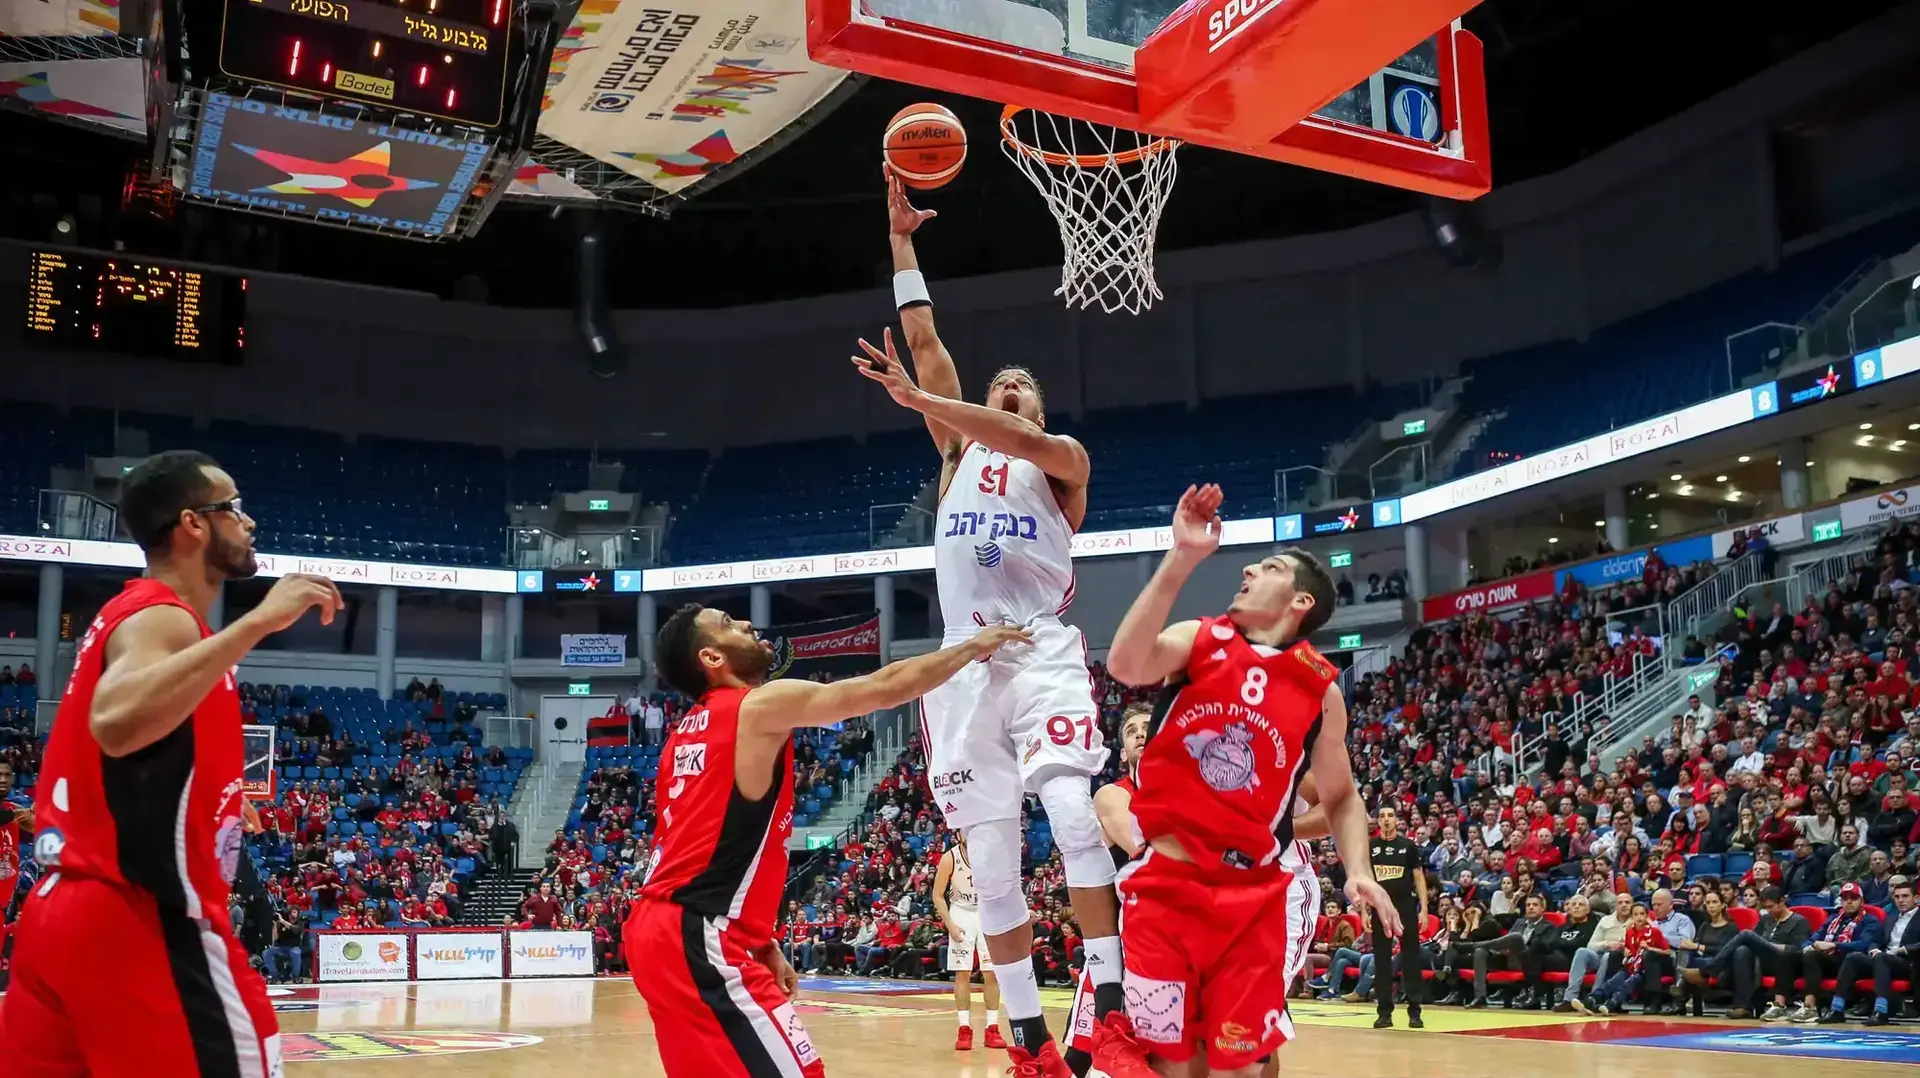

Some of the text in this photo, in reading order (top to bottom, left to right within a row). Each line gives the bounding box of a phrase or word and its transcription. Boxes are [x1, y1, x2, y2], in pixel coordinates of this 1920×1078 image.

[404, 16, 488, 51] גלבוע גליל
[594, 9, 672, 90] מתחילים כאן
[622, 53, 669, 93] דברים
[653, 14, 700, 53] טובים
[340, 74, 391, 96] Bodet
[902, 126, 951, 142] molten
[1861, 359, 1876, 380] 9
[1758, 391, 1771, 411] 8
[1615, 424, 1674, 450] ROZA
[945, 512, 1038, 540] בנק יהב
[1284, 520, 1296, 535] 7
[303, 563, 363, 577] ROZA
[757, 563, 809, 576] ROZA
[839, 556, 893, 569] ROZA
[395, 569, 455, 583] ROZA
[525, 575, 537, 589] 6
[619, 575, 631, 589] 7
[678, 569, 728, 582] ROZA
[1488, 584, 1517, 605] אשת
[797, 628, 878, 652] SUPPORTERS
[1241, 666, 1268, 705] 8
[1176, 702, 1223, 729] הגלבוע
[1227, 703, 1269, 731] אזורית
[1047, 715, 1093, 751] 91
